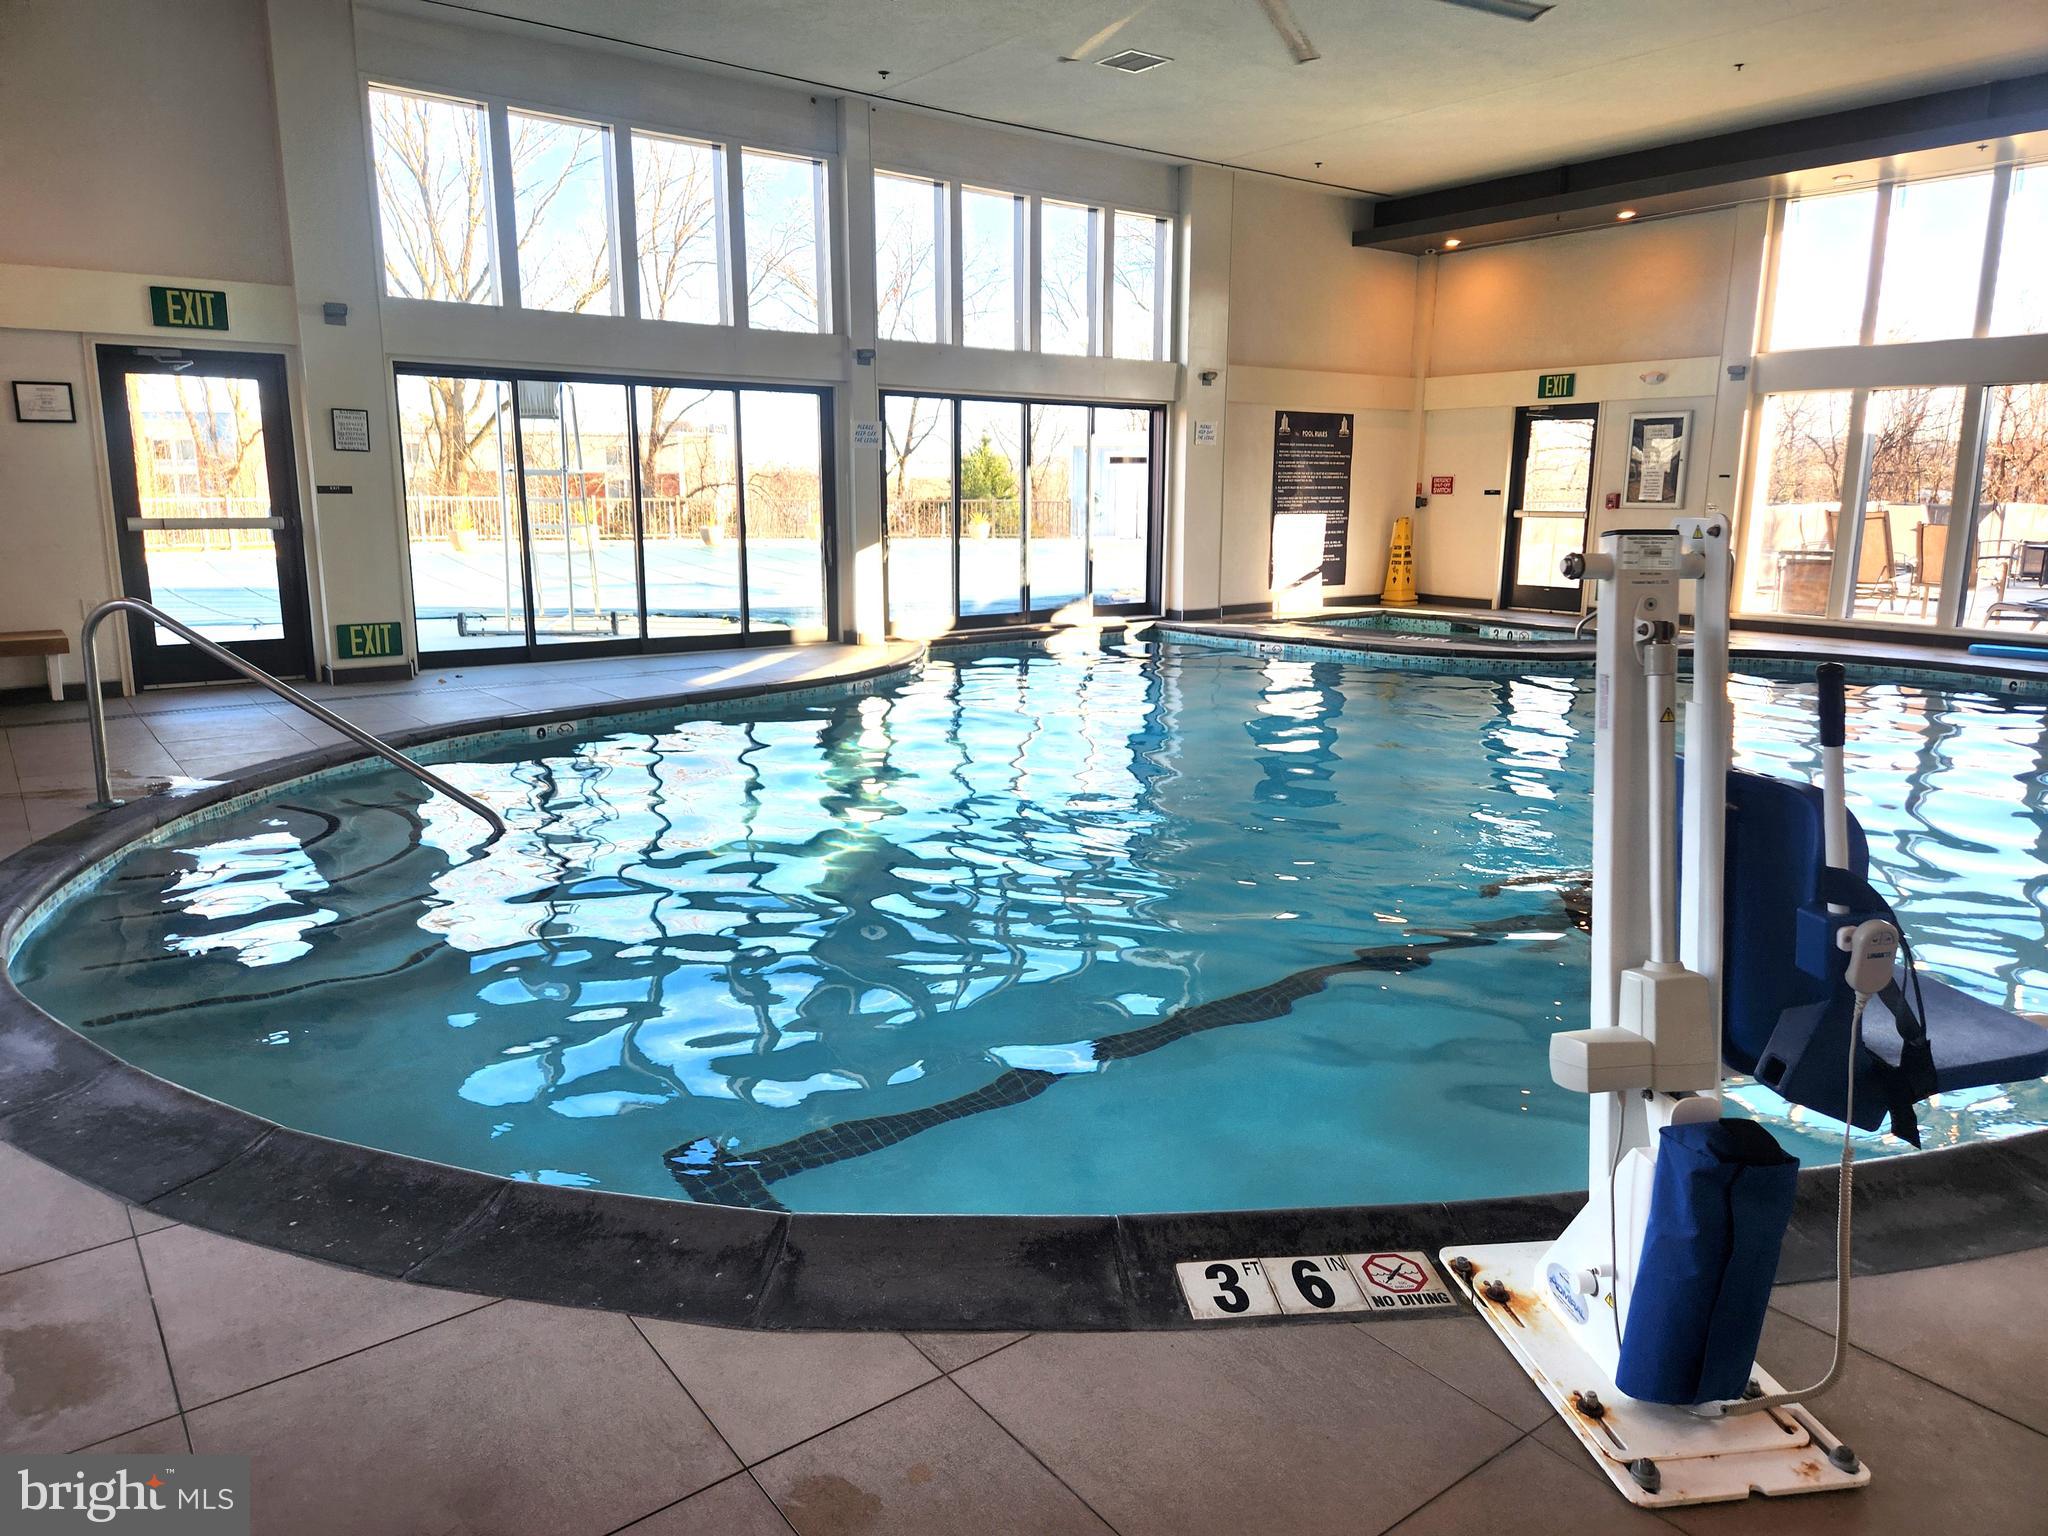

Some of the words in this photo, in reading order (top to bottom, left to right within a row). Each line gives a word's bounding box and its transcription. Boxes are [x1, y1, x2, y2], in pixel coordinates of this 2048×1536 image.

[166, 290, 215, 326] EXIT
[1545, 375, 1570, 397] EXIT
[1302, 430, 1314, 438] POOL
[1314, 430, 1328, 438] RULES
[350, 624, 391, 656] EXIT
[1205, 1263, 1250, 1314] 3
[1243, 1261, 1261, 1276] FT
[1291, 1260, 1336, 1309] 6
[1324, 1256, 1347, 1273] IN
[1371, 1295, 1395, 1308] NO
[1397, 1292, 1450, 1306] DIVING
